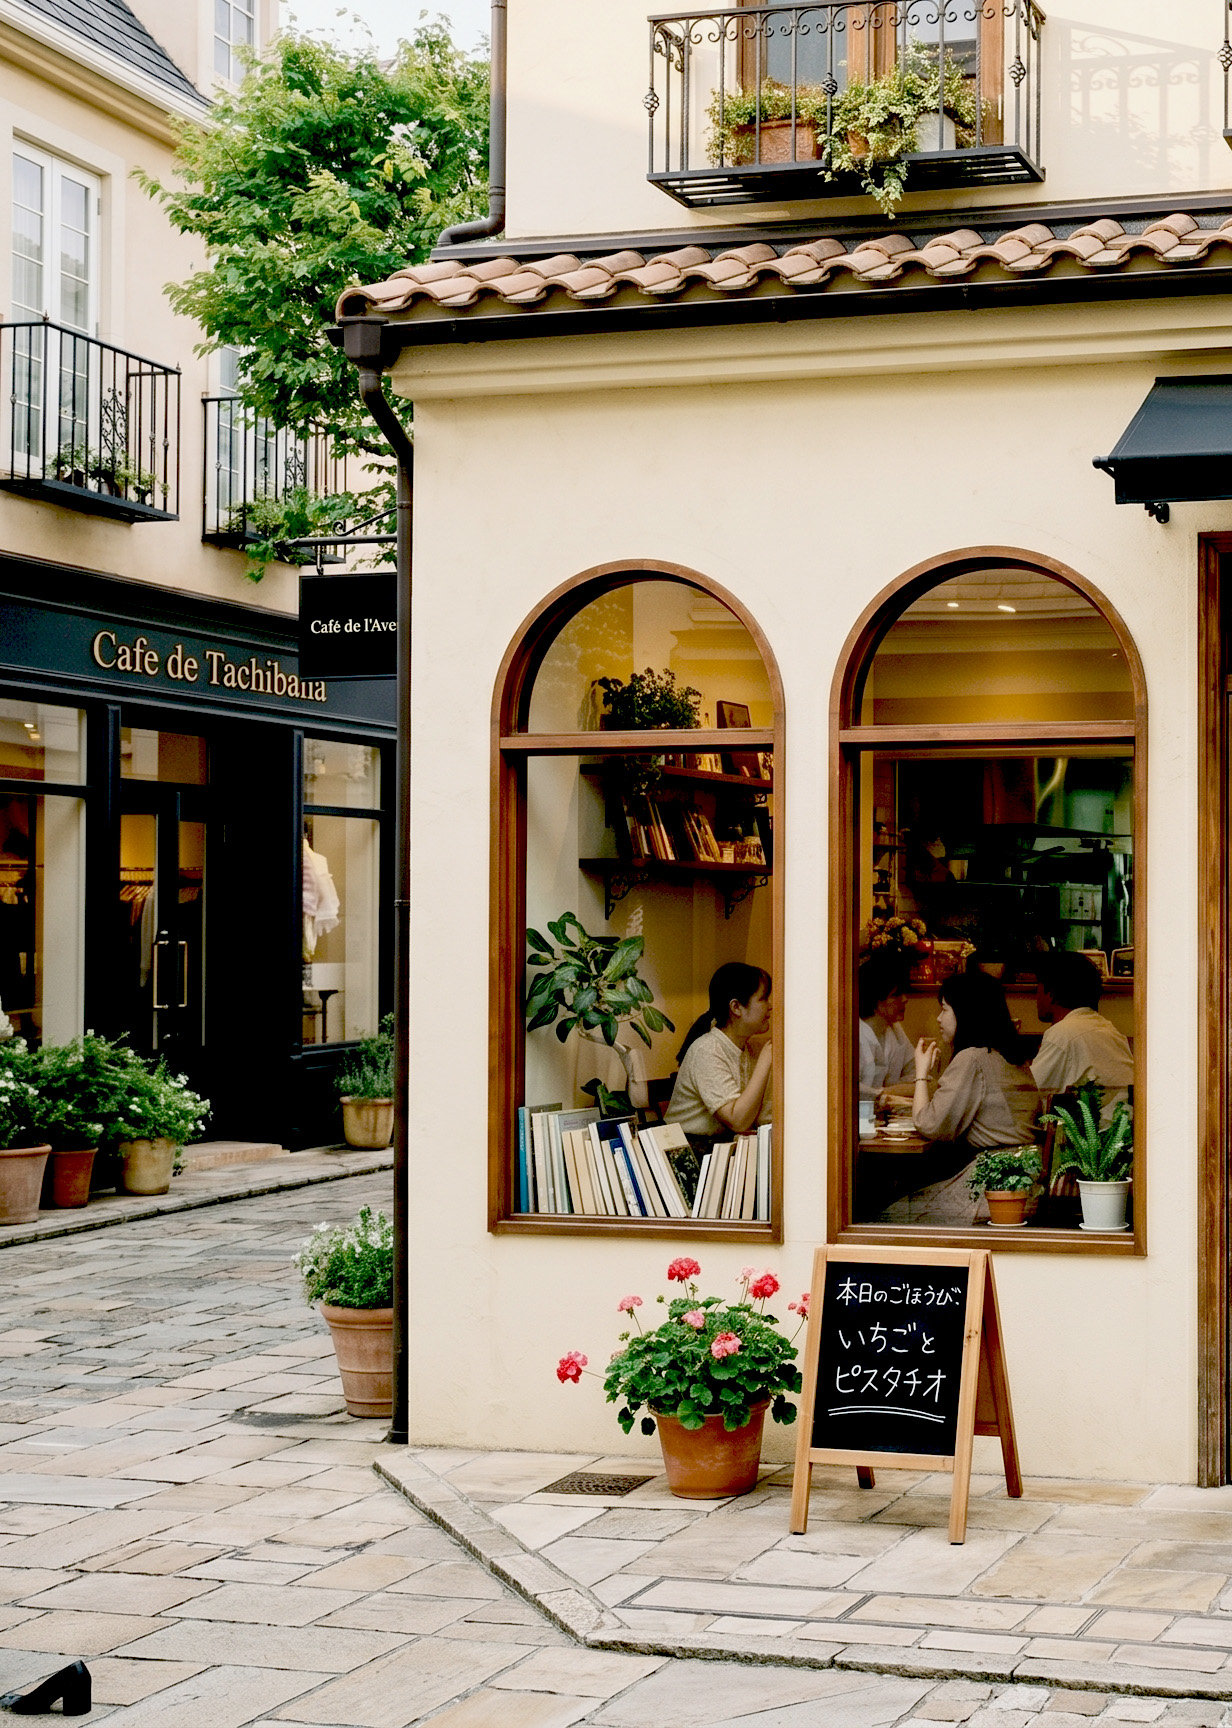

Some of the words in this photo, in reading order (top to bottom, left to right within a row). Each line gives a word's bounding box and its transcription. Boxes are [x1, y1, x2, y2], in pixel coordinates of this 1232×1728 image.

[310, 618, 341, 634] Café
[344, 618, 361, 633] de
[363, 618, 398, 632] l'Ave
[92, 630, 159, 676] Cafe
[166, 644, 199, 683] de
[205, 650, 327, 702] Tachibana
[838, 1321, 936, 1354] いちごと
[835, 1364, 947, 1403] ピスタチオ
